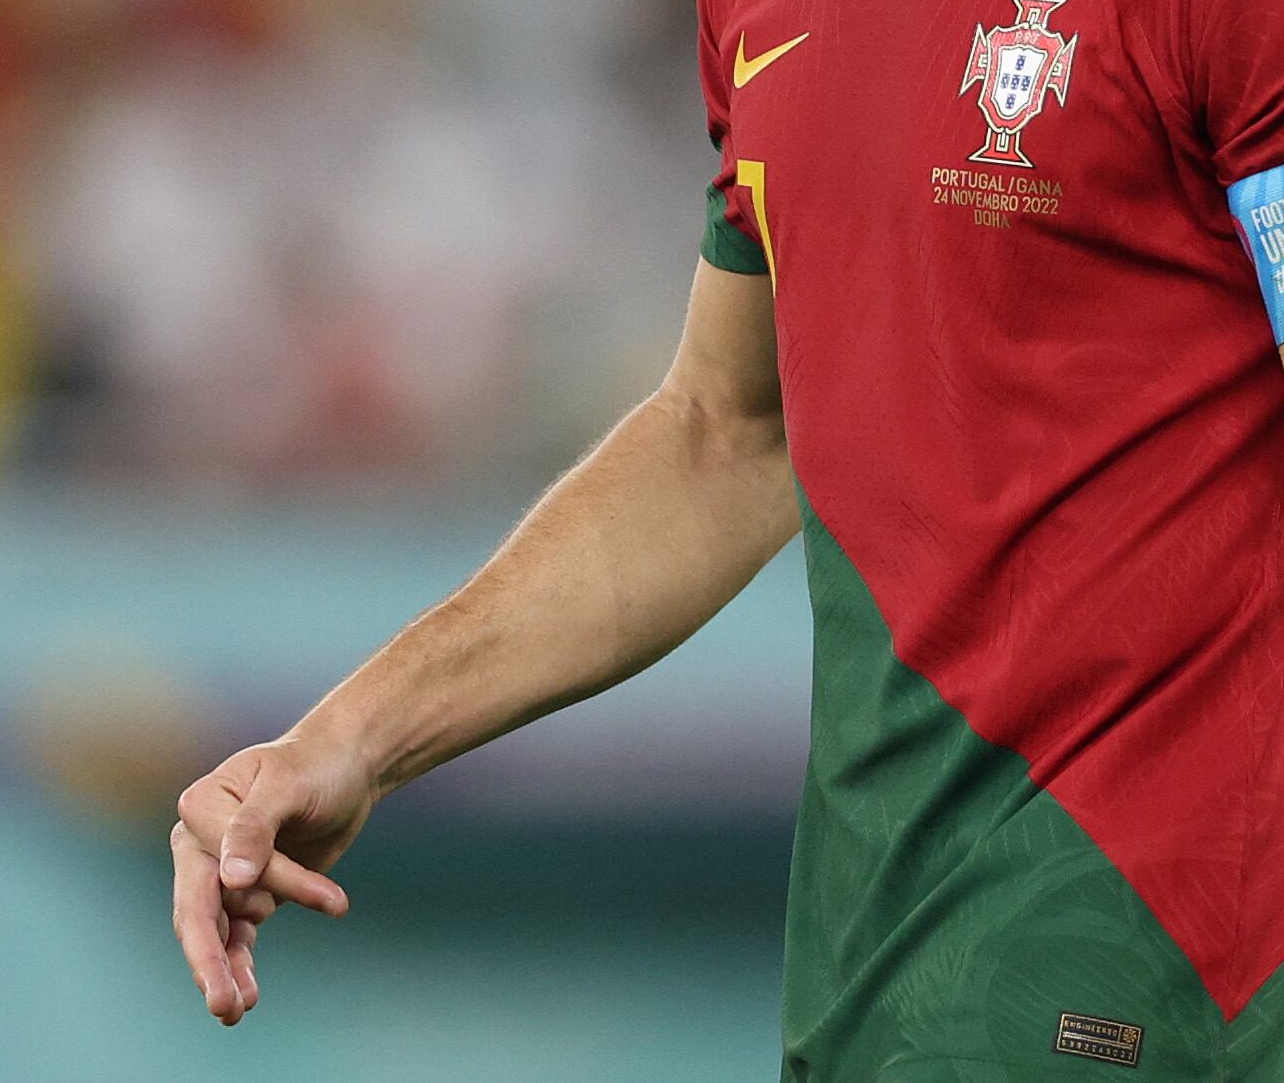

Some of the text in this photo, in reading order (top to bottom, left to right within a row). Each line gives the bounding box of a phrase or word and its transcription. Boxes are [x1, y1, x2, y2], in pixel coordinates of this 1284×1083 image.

[933, 186, 1059, 215] 24 NOVEMBRO 2022
[737, 159, 776, 299] 7
[973, 209, 1010, 228] DOHA
